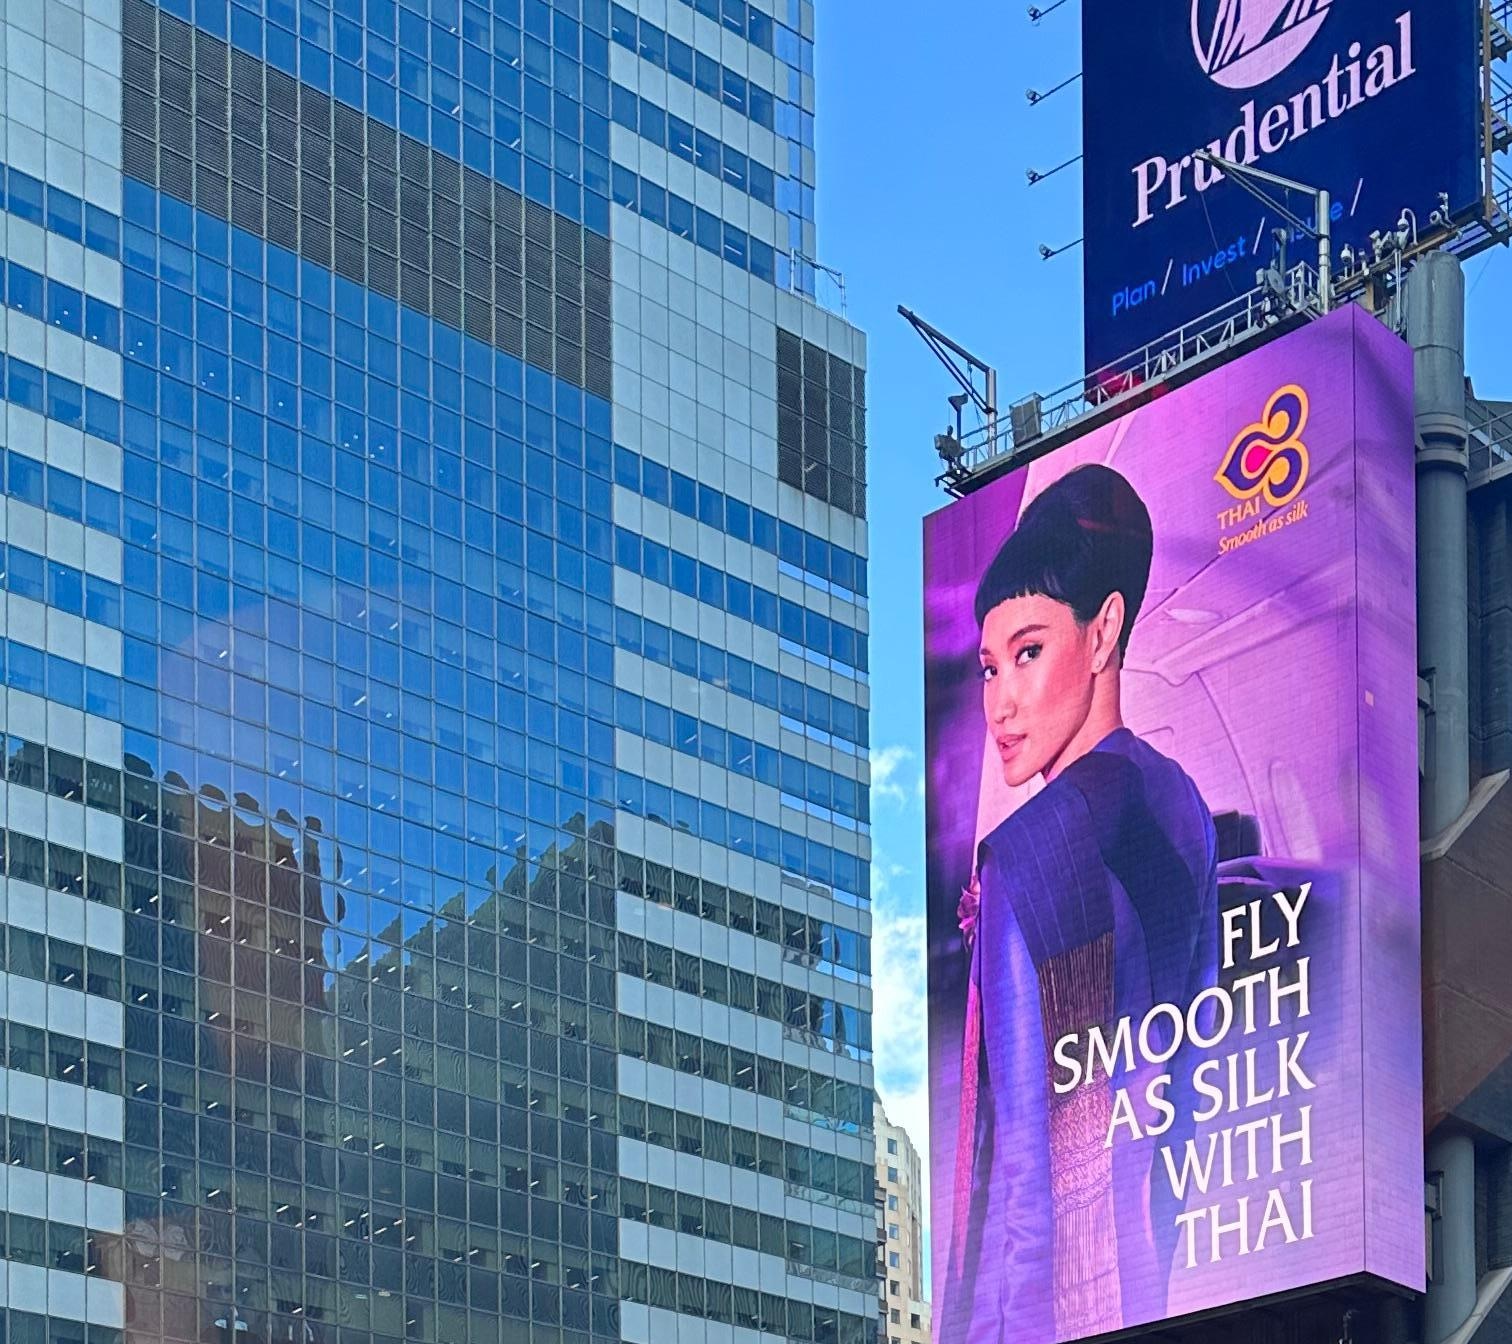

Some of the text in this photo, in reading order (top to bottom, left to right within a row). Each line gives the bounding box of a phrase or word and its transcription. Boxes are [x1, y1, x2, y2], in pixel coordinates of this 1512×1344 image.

[1131, 11, 1416, 228] Prudential
[1111, 278, 1156, 317] Plan
[1182, 235, 1246, 287] Invest
[1216, 496, 1260, 530] THAI
[1218, 500, 1308, 555] Smooth as silk
[1221, 881, 1313, 969] FLY
[1053, 956, 1310, 1094] SMOOTH
[1104, 1031, 1317, 1149] AS SILK
[1160, 1105, 1313, 1201] WITH
[1174, 1180, 1315, 1269] THAI
